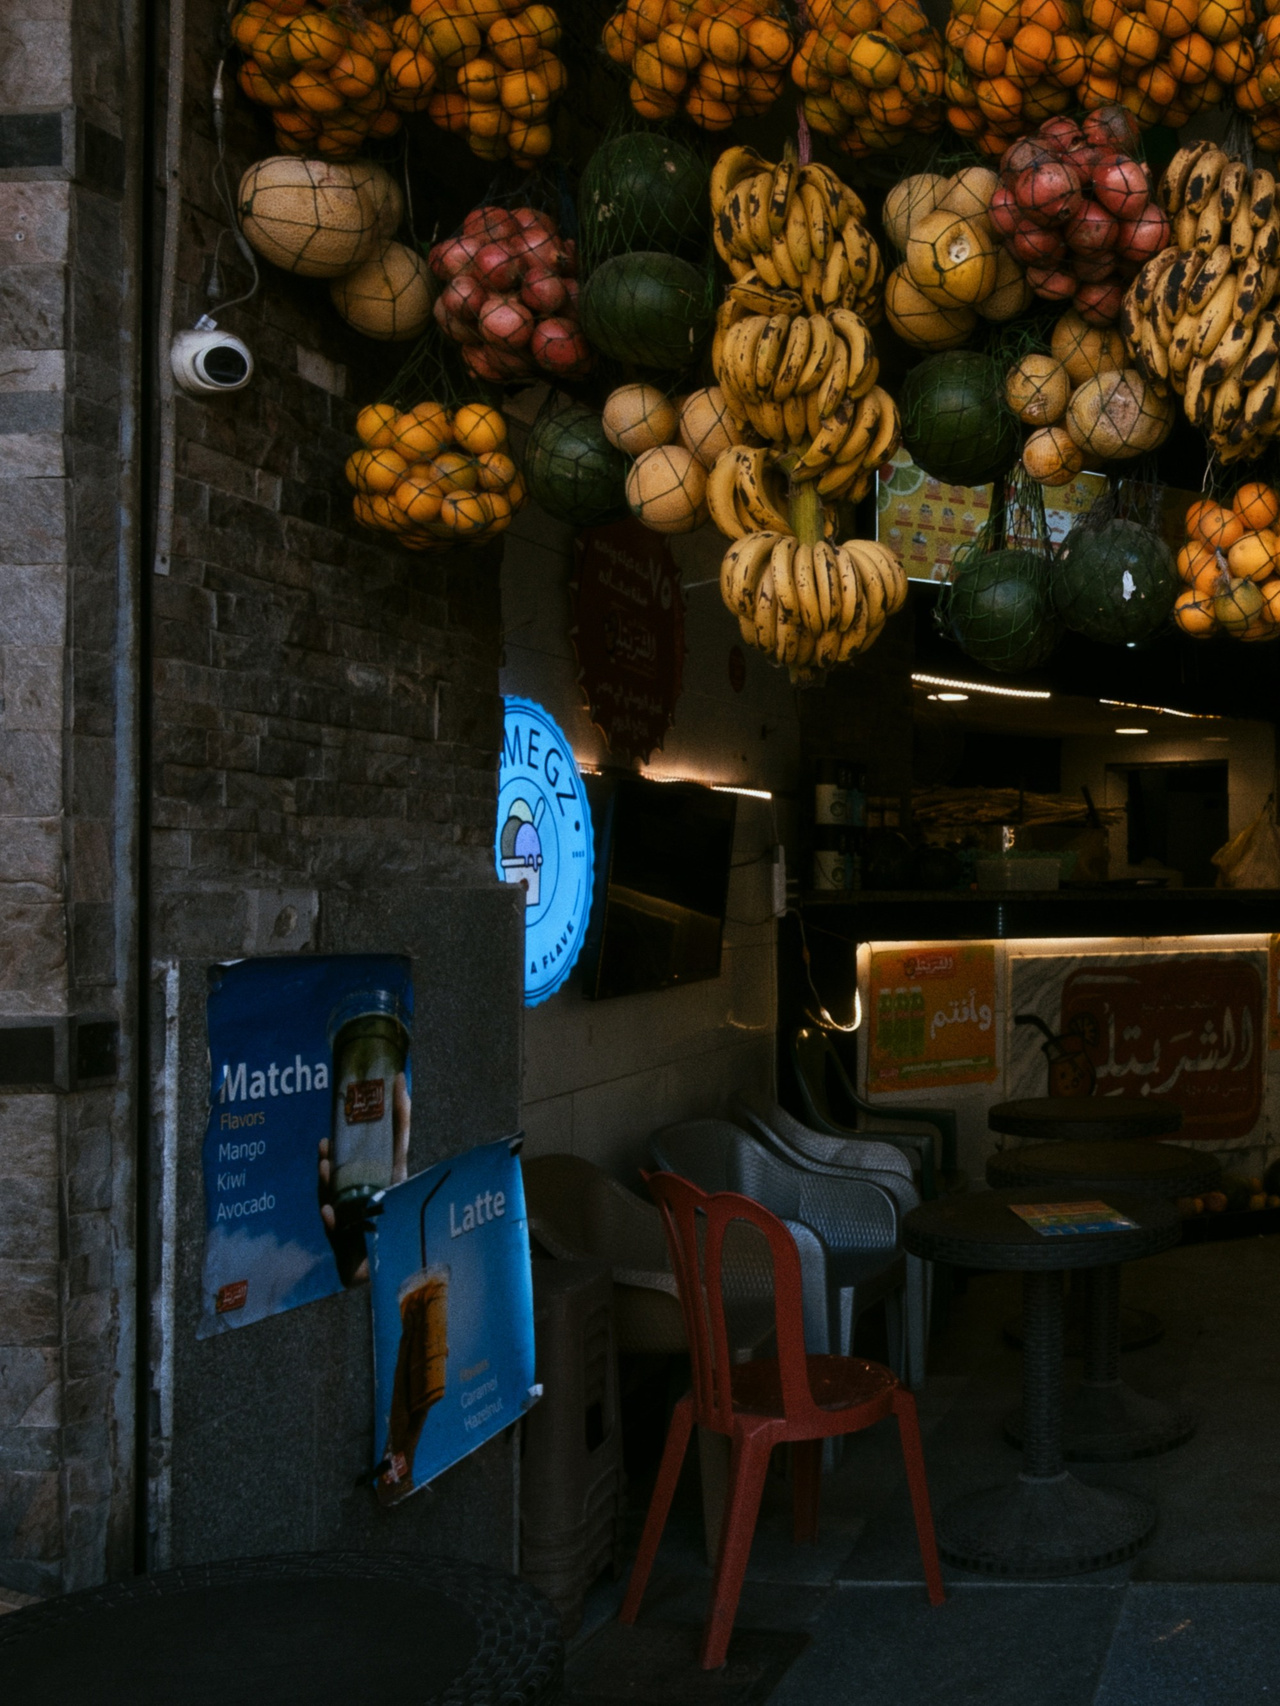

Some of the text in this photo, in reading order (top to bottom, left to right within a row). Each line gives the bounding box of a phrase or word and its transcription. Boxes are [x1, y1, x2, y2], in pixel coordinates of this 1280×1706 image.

[500, 725, 578, 817] MEGZ
[930, 988, 992, 1041] وأنتم
[219, 1053, 329, 1105] Matcha
[219, 1111, 266, 1132] Flavors
[218, 1139, 266, 1163] Mango
[216, 1168, 247, 1193] Kiwi
[216, 1191, 276, 1223] Avocado
[449, 1189, 506, 1239] Latte
[460, 1374, 499, 1409] Caramel
[463, 1396, 504, 1432] Hazelnut
